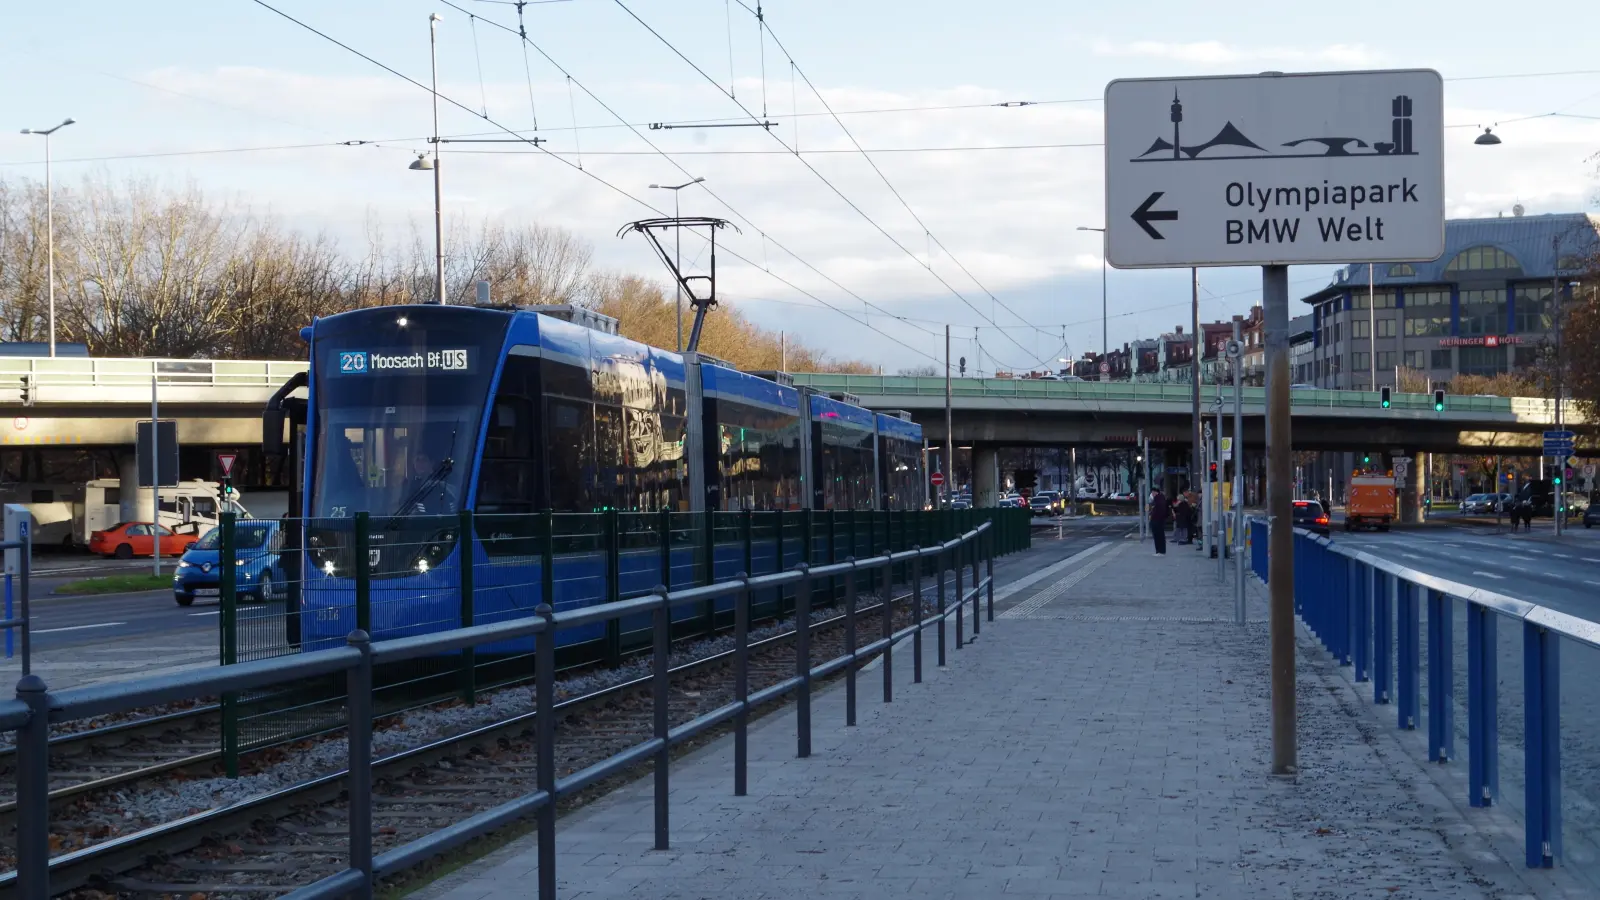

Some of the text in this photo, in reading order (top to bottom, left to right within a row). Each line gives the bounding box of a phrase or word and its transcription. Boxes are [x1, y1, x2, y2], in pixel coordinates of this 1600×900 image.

[1226, 178, 1418, 212] Olympiapark
[1226, 216, 1384, 244] BMW Welt
[342, 354, 364, 370] 20
[371, 353, 423, 369] Moosach
[330, 506, 346, 518] 25
